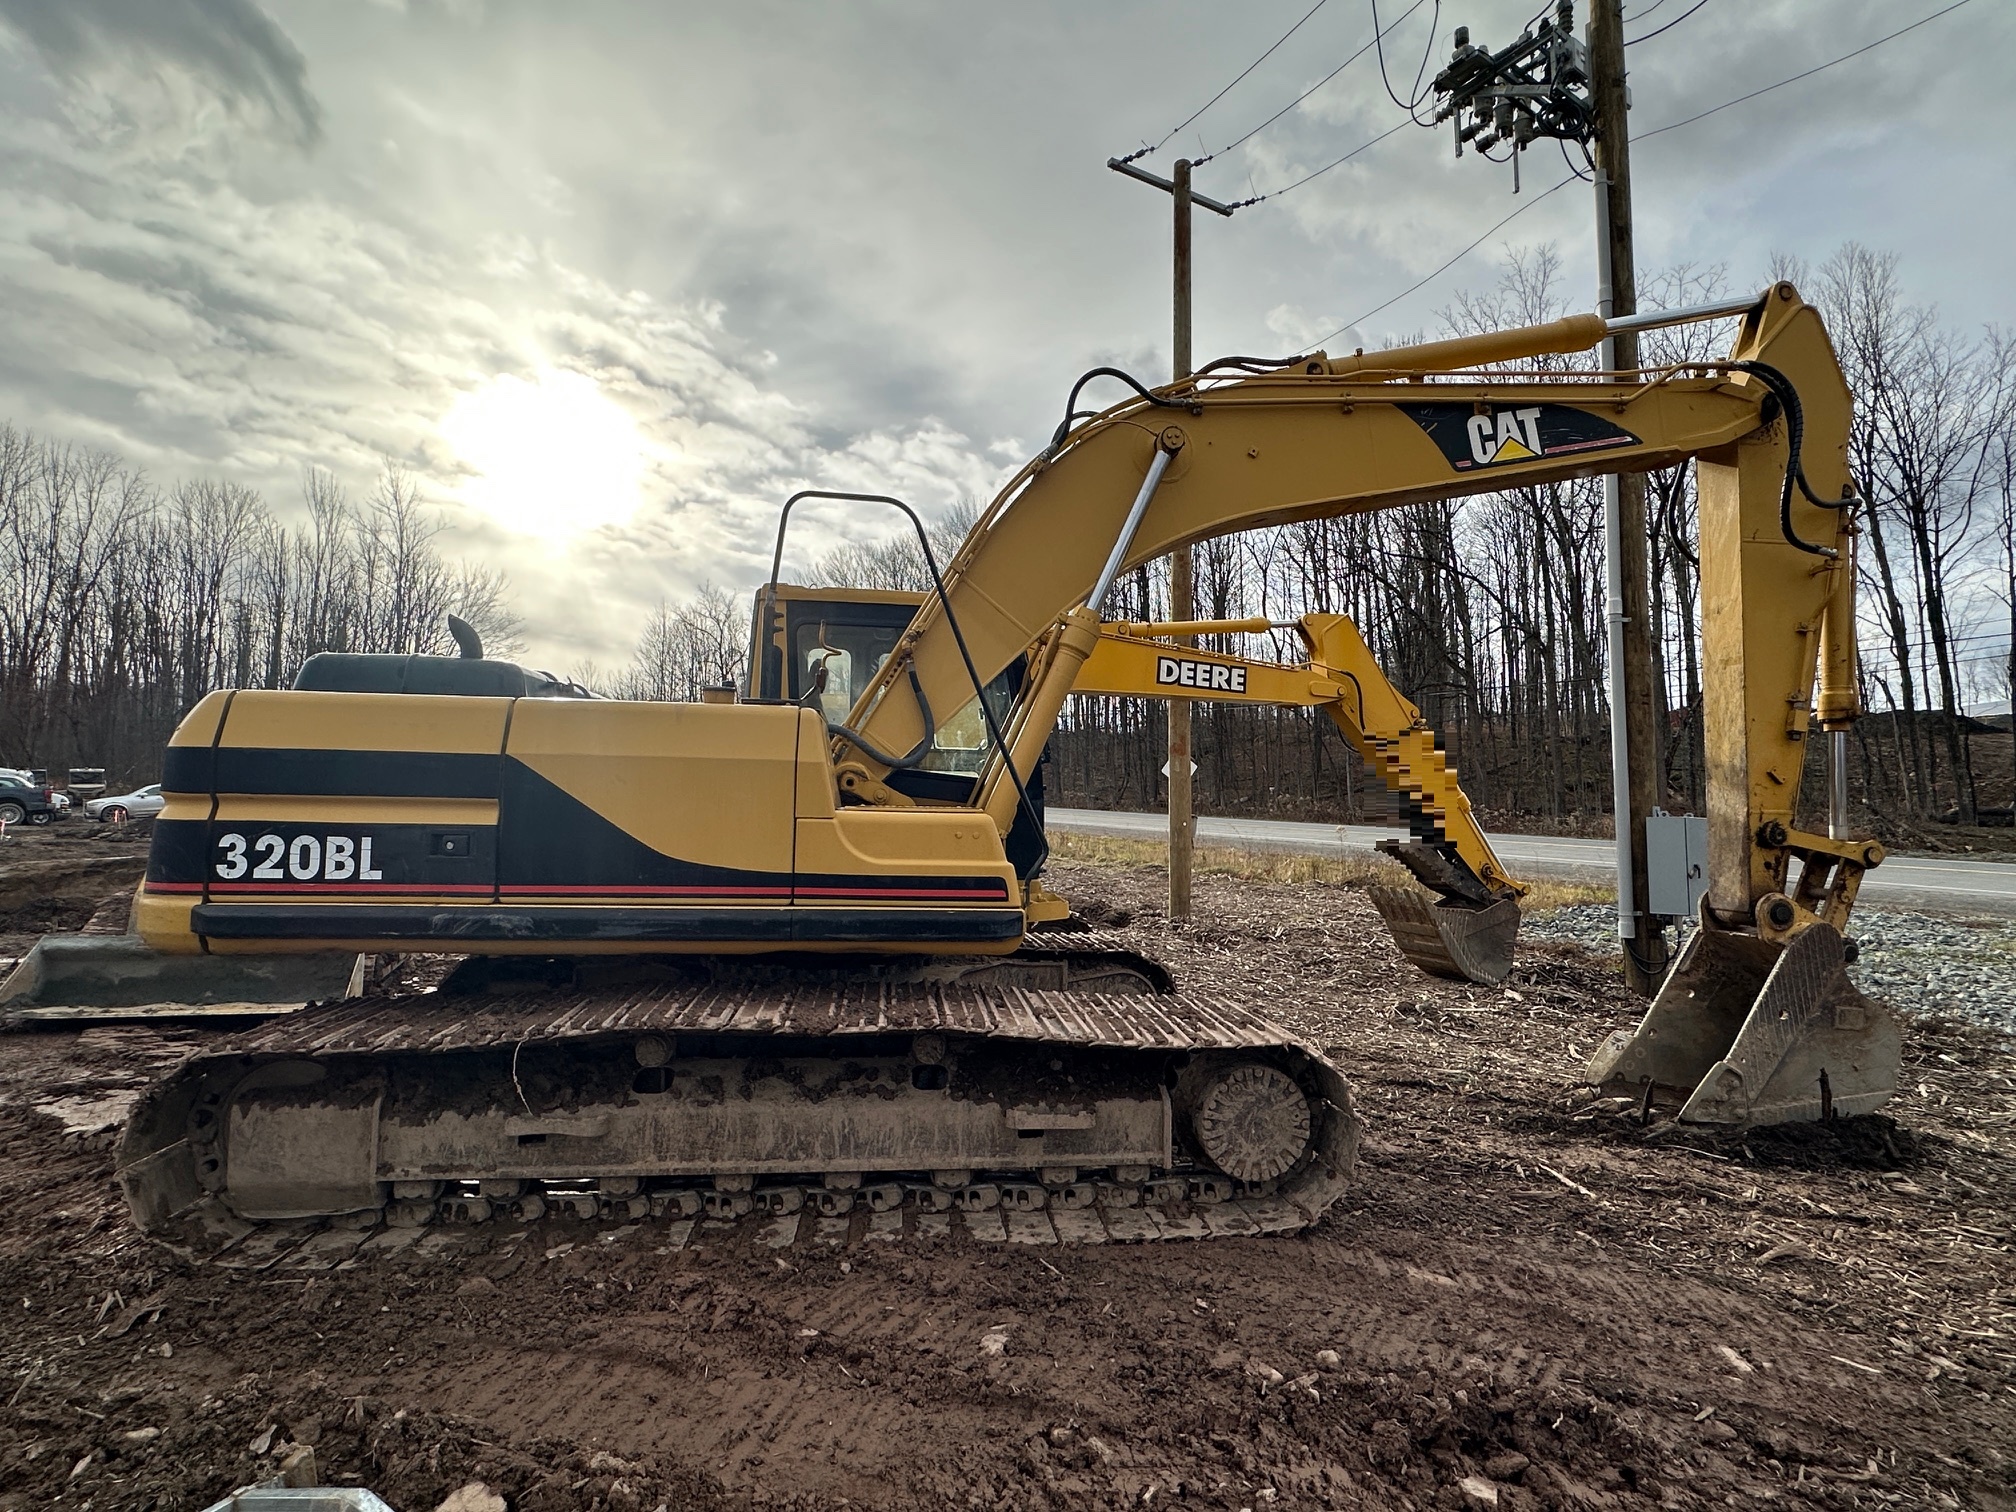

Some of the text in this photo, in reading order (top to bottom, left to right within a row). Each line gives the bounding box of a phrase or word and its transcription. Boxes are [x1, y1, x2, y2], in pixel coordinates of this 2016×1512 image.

[1466, 407, 1543, 464] CAT
[1159, 659, 1245, 692] DEERE
[215, 833, 383, 880] 320BL
